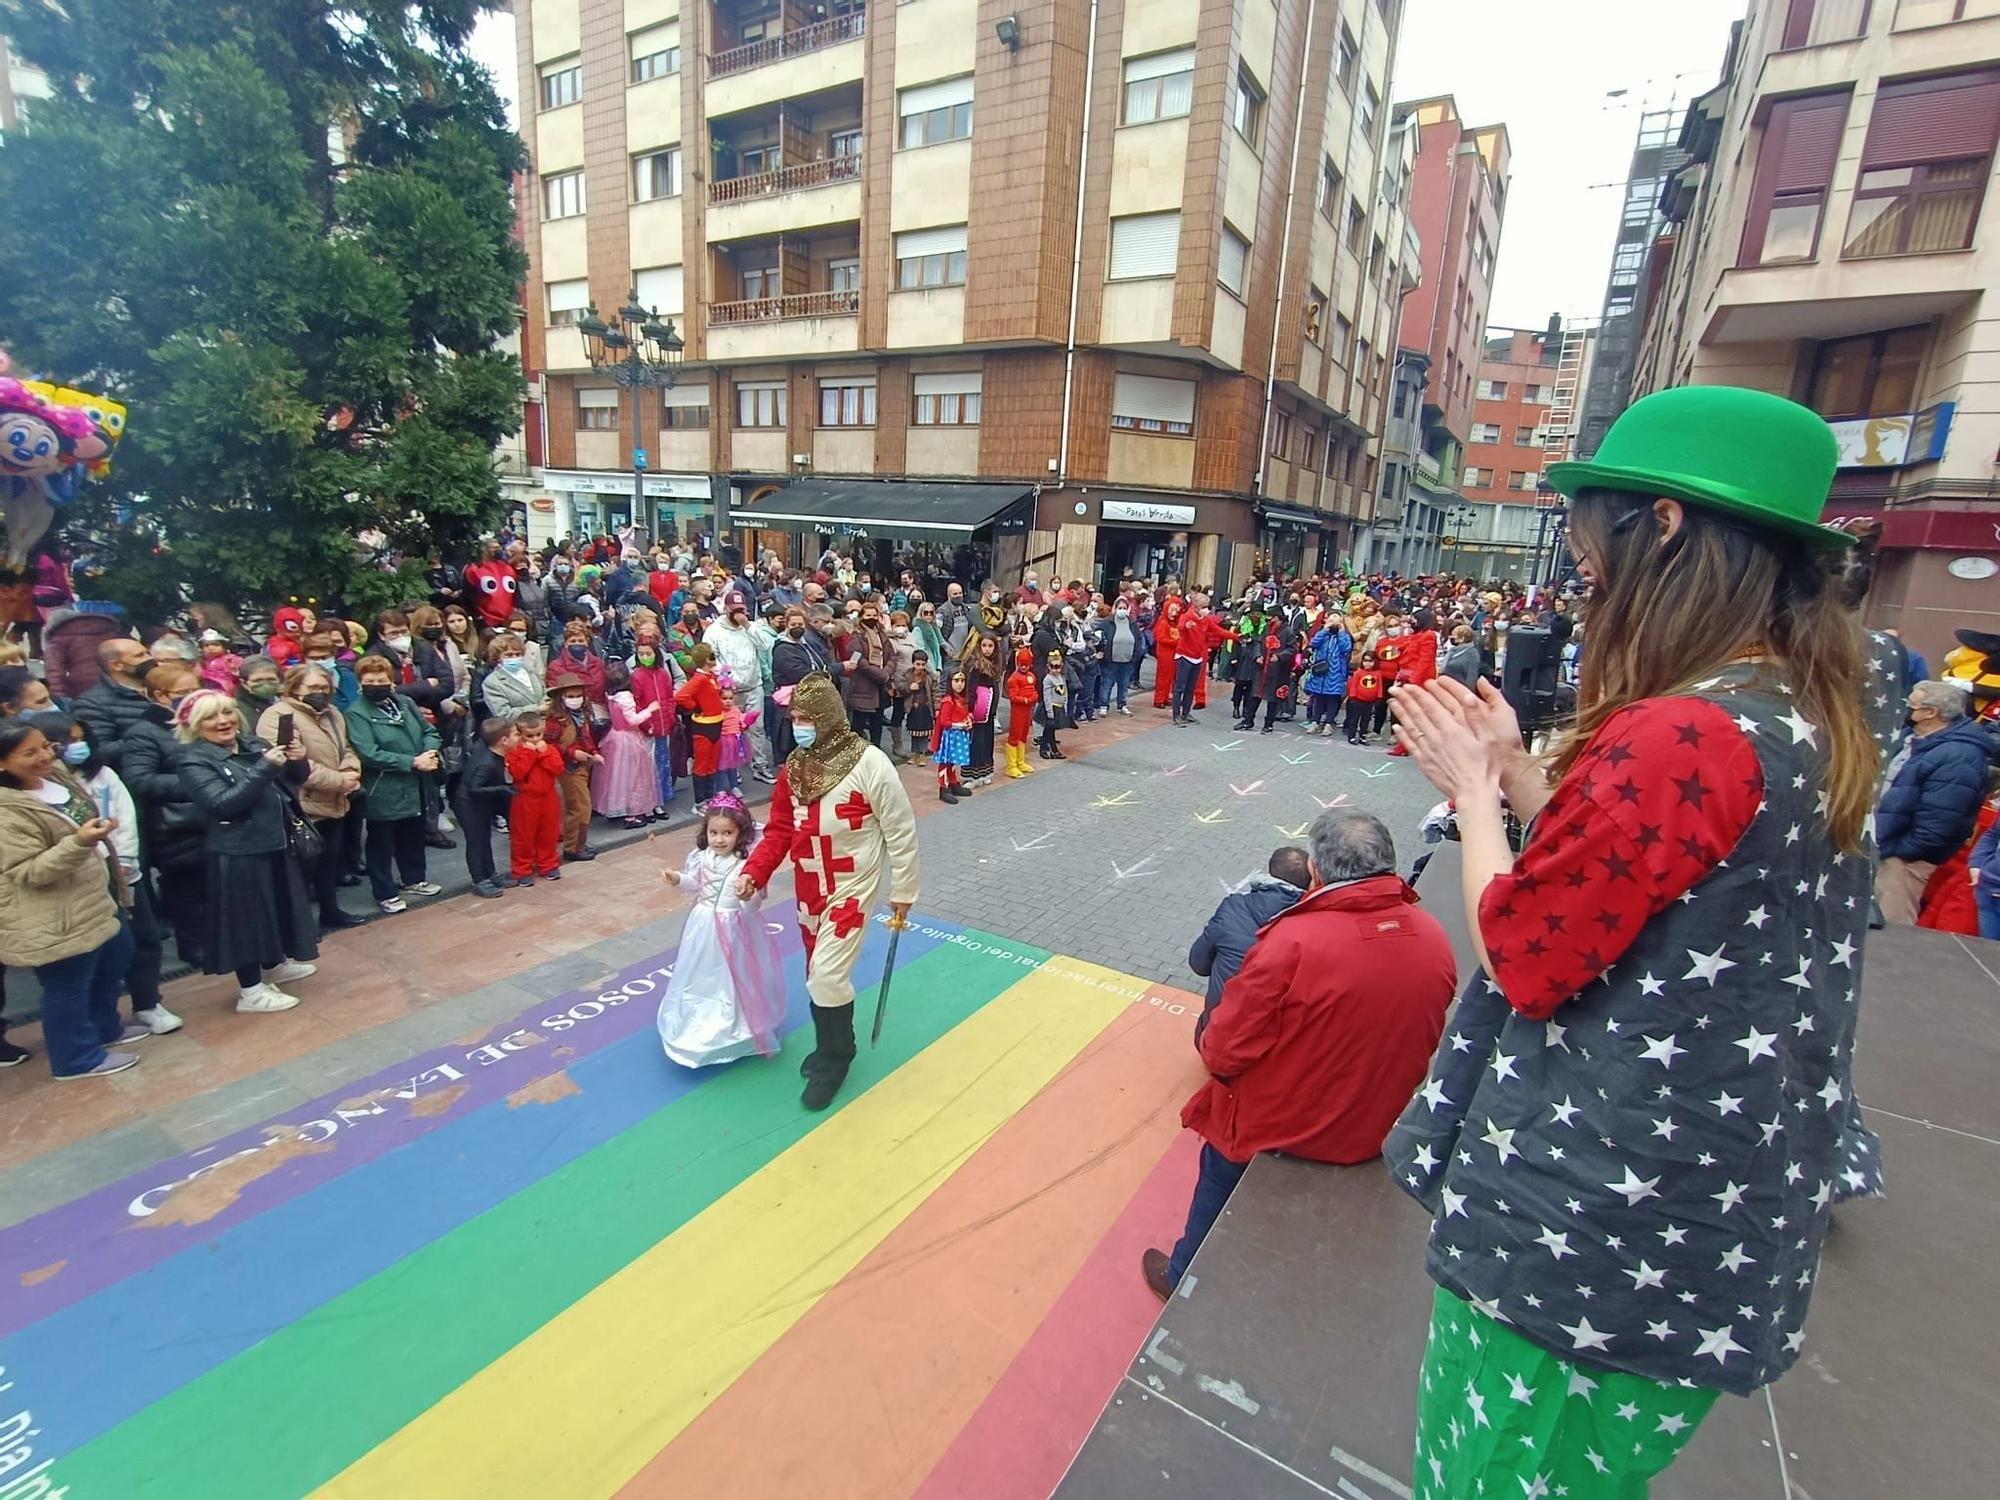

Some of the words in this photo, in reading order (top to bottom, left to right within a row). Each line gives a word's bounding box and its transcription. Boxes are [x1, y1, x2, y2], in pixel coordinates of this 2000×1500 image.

[922, 926, 982, 951] Orgullo
[982, 945, 1014, 960] del
[1013, 956, 1145, 1002] Internacional
[1150, 996, 1186, 1016] Día
